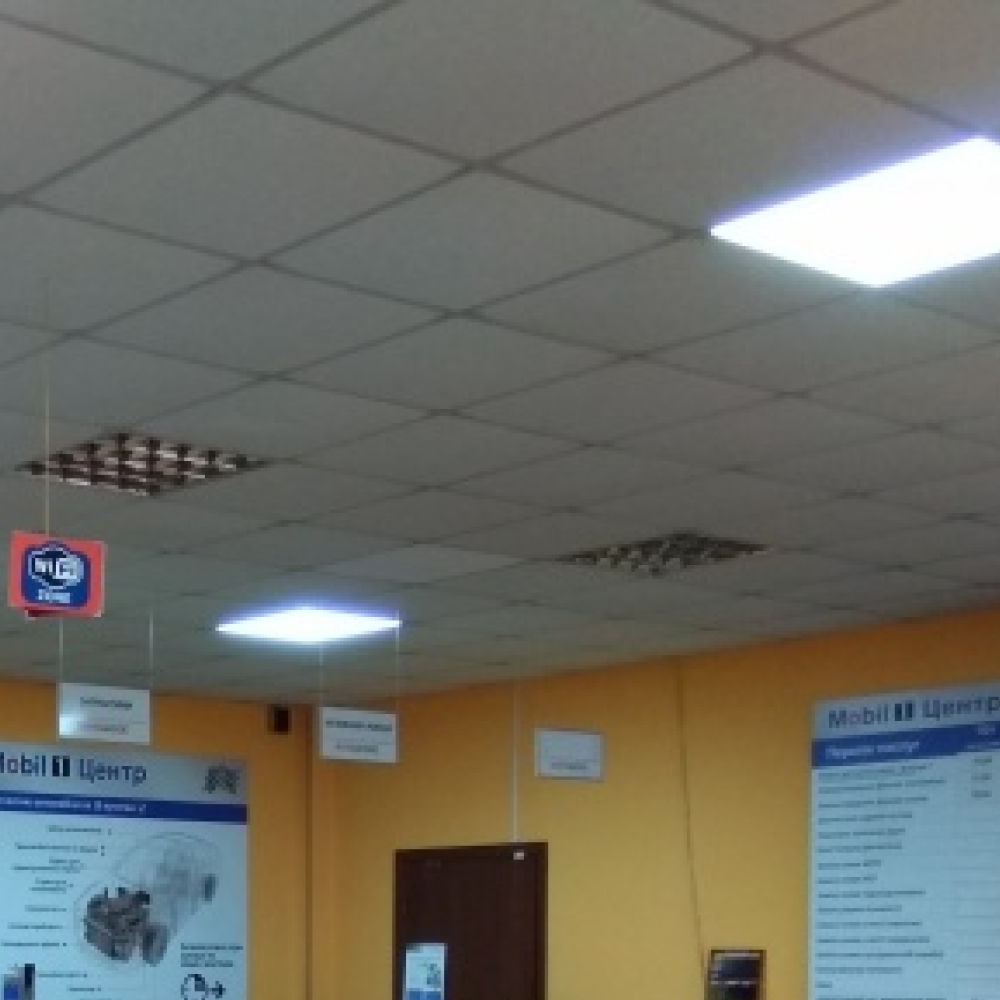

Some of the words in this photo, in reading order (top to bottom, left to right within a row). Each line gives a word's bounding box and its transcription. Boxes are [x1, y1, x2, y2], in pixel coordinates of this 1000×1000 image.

[829, 703, 889, 729] Mobil
[922, 695, 1000, 722] Центр
[78, 758, 147, 788] Центр
